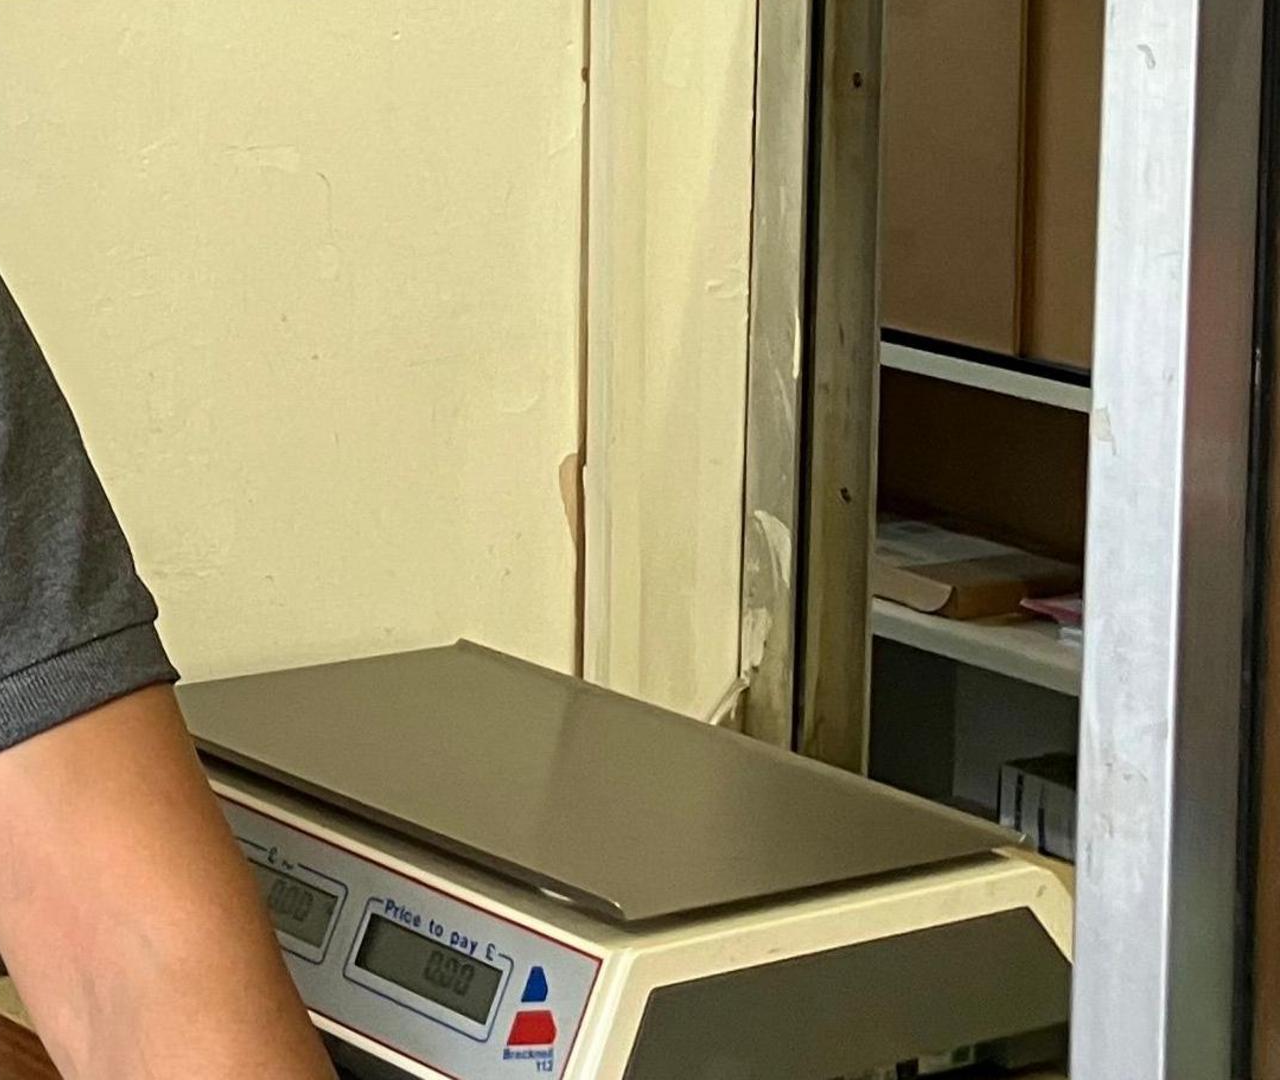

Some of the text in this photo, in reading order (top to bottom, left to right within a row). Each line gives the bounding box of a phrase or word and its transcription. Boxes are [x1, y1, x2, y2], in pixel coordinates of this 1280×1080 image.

[384, 899, 422, 927] Price
[429, 919, 444, 937] to
[450, 931, 479, 955] pay
